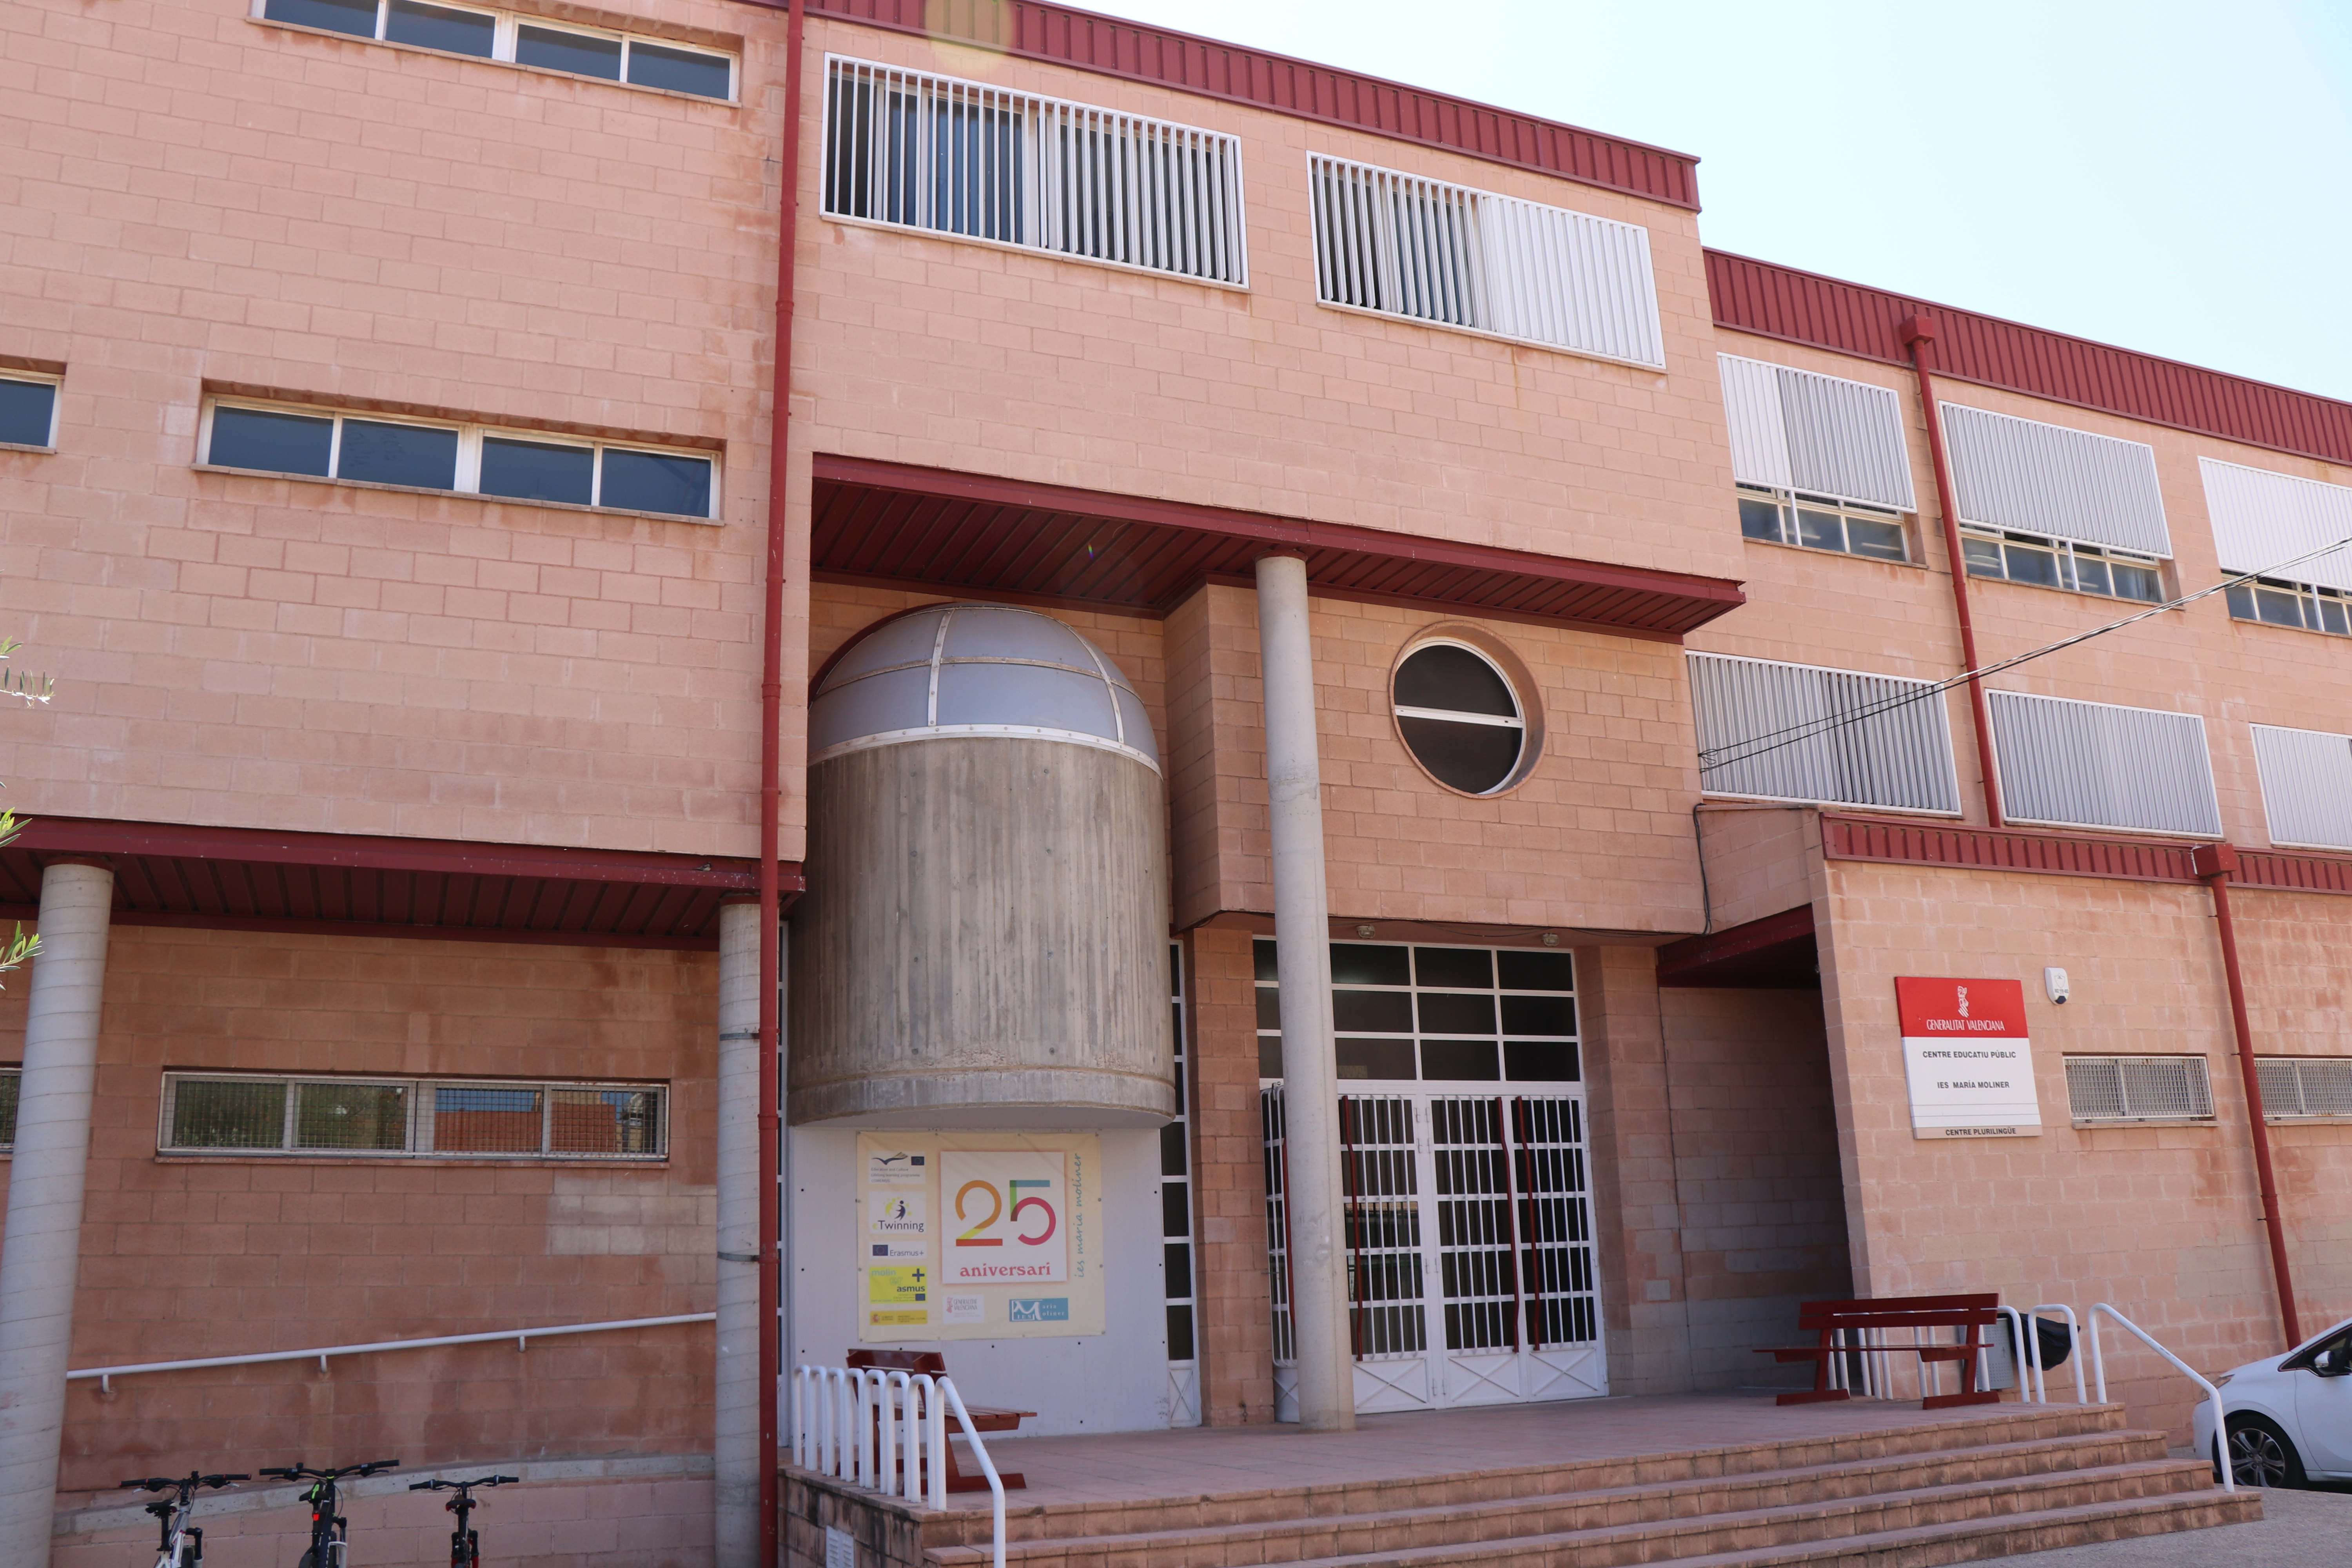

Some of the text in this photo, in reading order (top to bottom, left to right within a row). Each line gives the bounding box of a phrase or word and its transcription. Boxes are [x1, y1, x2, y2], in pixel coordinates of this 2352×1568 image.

[1926, 1019, 2005, 1031] GENERALITAT VALENCIANA
[1991, 1049, 2016, 1058] PÚBLIC
[1953, 1080, 1976, 1089] MARÍA
[1973, 1127, 2016, 1135] PLURILINGÜE
[955, 1180, 1056, 1247] 25
[1072, 1153, 1085, 1278] ies maria moliner
[872, 1220, 924, 1232] eTwinning
[960, 1262, 1051, 1277] aniversari
